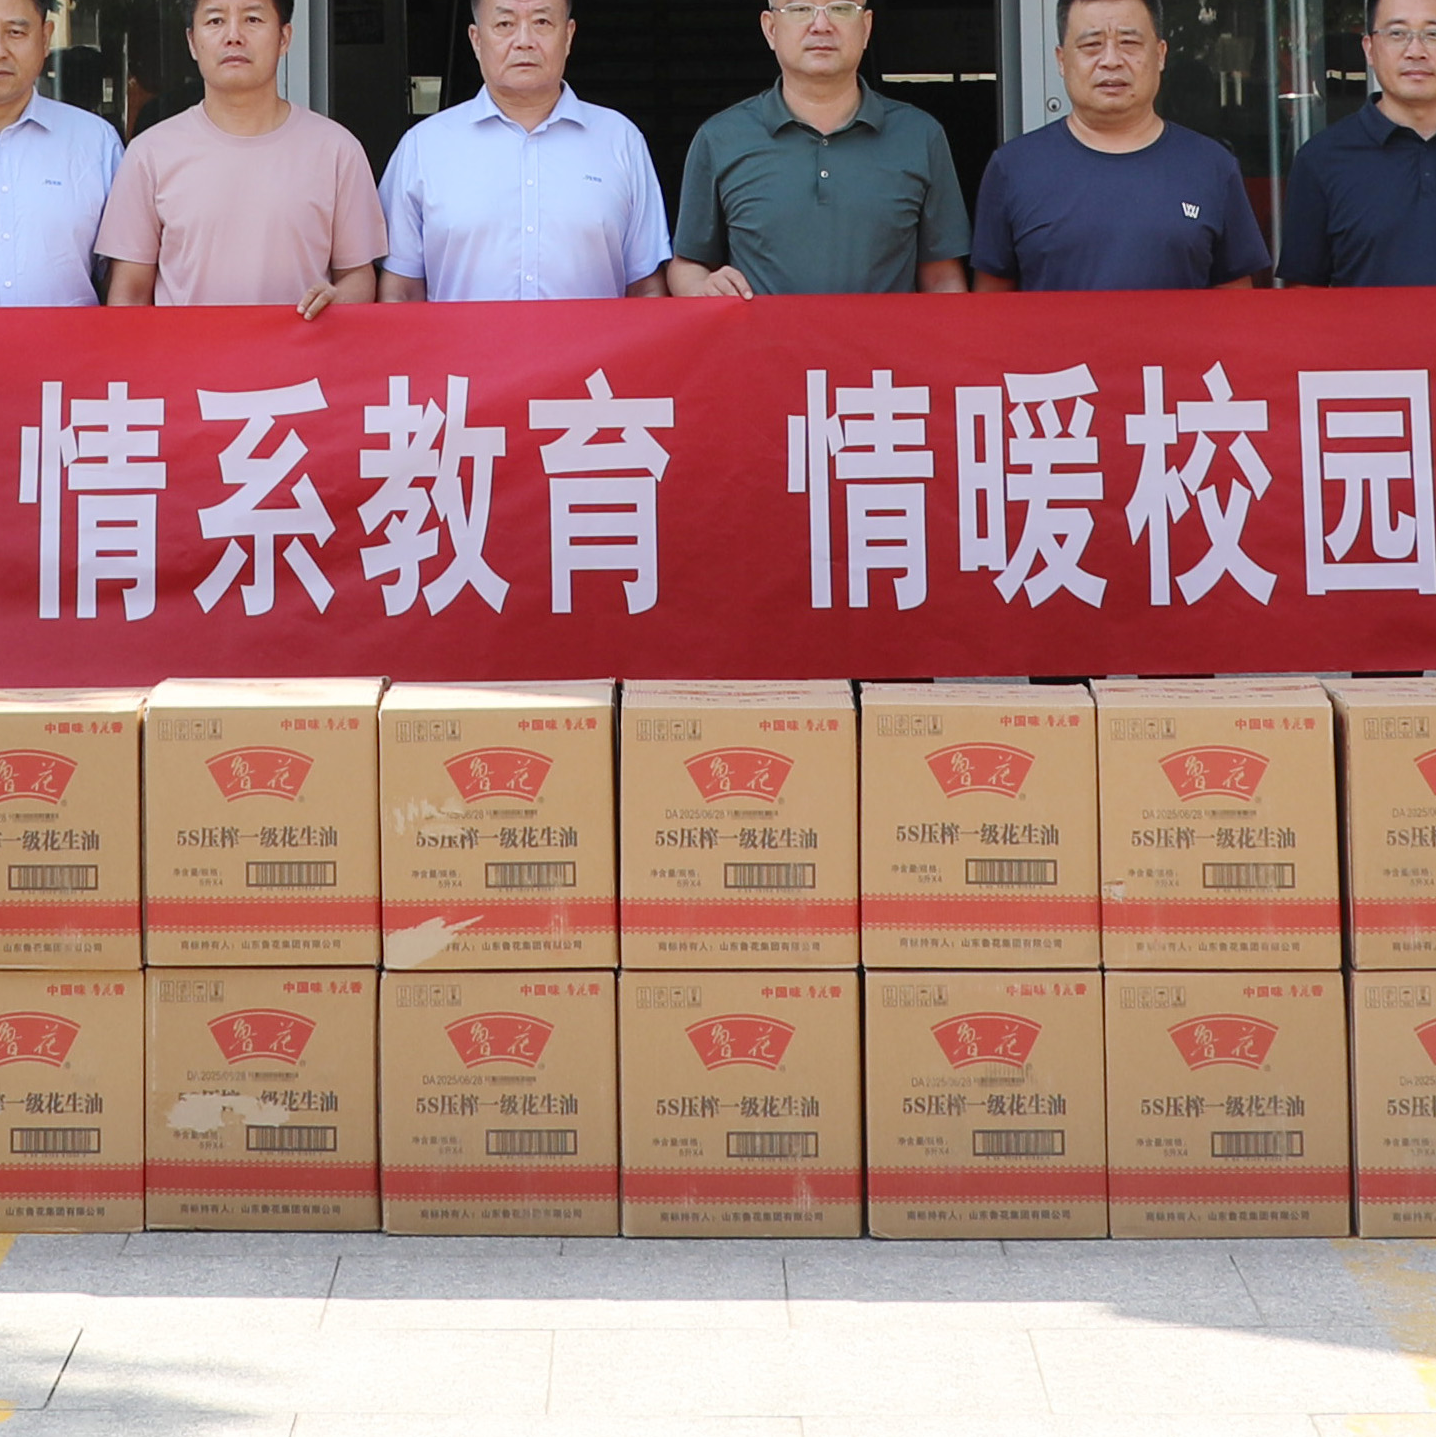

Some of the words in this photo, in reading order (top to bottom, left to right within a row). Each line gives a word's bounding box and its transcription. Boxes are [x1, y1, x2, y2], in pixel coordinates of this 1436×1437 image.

[279, 718, 321, 730] 中国味
[518, 719, 558, 731] 中国味
[758, 719, 800, 731] 中国味
[1000, 715, 1040, 727] 中国味
[1235, 718, 1275, 730] 中国味
[44, 722, 84, 734] 中国味
[176, 827, 338, 849] 5S压榨一级花生油
[654, 827, 819, 849] 5S压榨一级花生油
[895, 823, 1060, 845] 5S压榨一级花生油
[1130, 827, 1297, 849] 5S压榨一级花生油
[47, 984, 86, 995] 中国味
[283, 981, 323, 993] 中国味
[520, 984, 560, 996] 中国味
[761, 986, 802, 998] 中国味
[1005, 984, 1047, 996] 中国味
[1244, 986, 1283, 997] 中国味
[415, 1094, 578, 1116] 5S压榨一级花生油
[655, 1096, 820, 1118] 5S压榨一级花生油
[901, 1094, 1068, 1116] 5S压榨一级花生油
[1140, 1096, 1305, 1118] 5S压榨一级花生油
